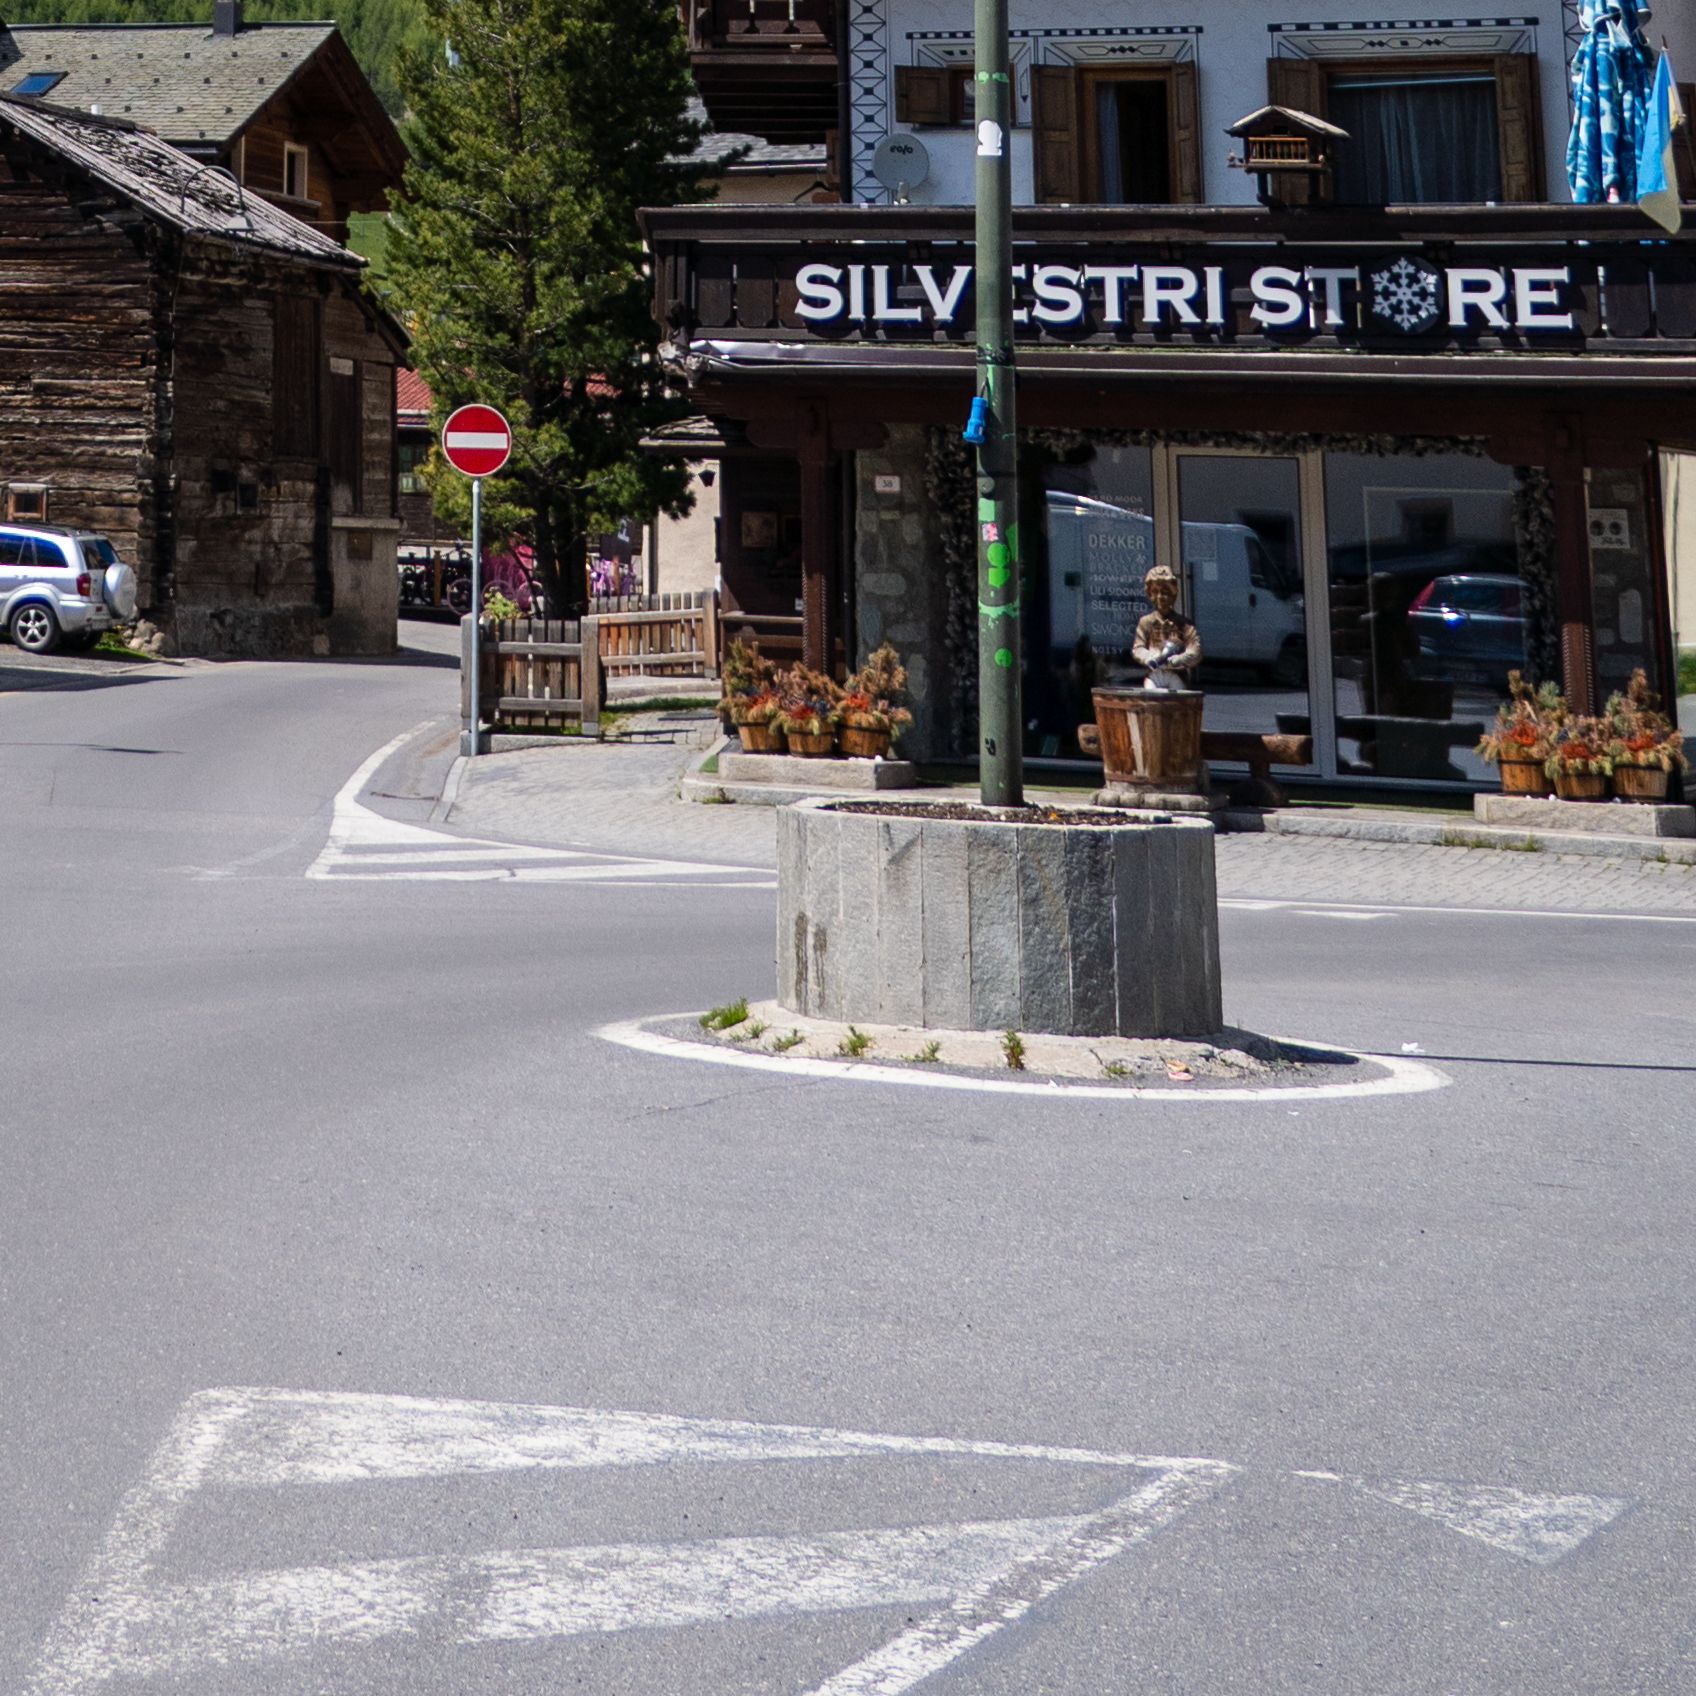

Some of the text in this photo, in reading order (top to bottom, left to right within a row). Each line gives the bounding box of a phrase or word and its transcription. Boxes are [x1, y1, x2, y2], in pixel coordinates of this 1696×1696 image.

[794, 263, 1224, 325] SILVSTRI
[1088, 534, 1146, 550] DEKKER
[1091, 599, 1148, 612] SELECTED
